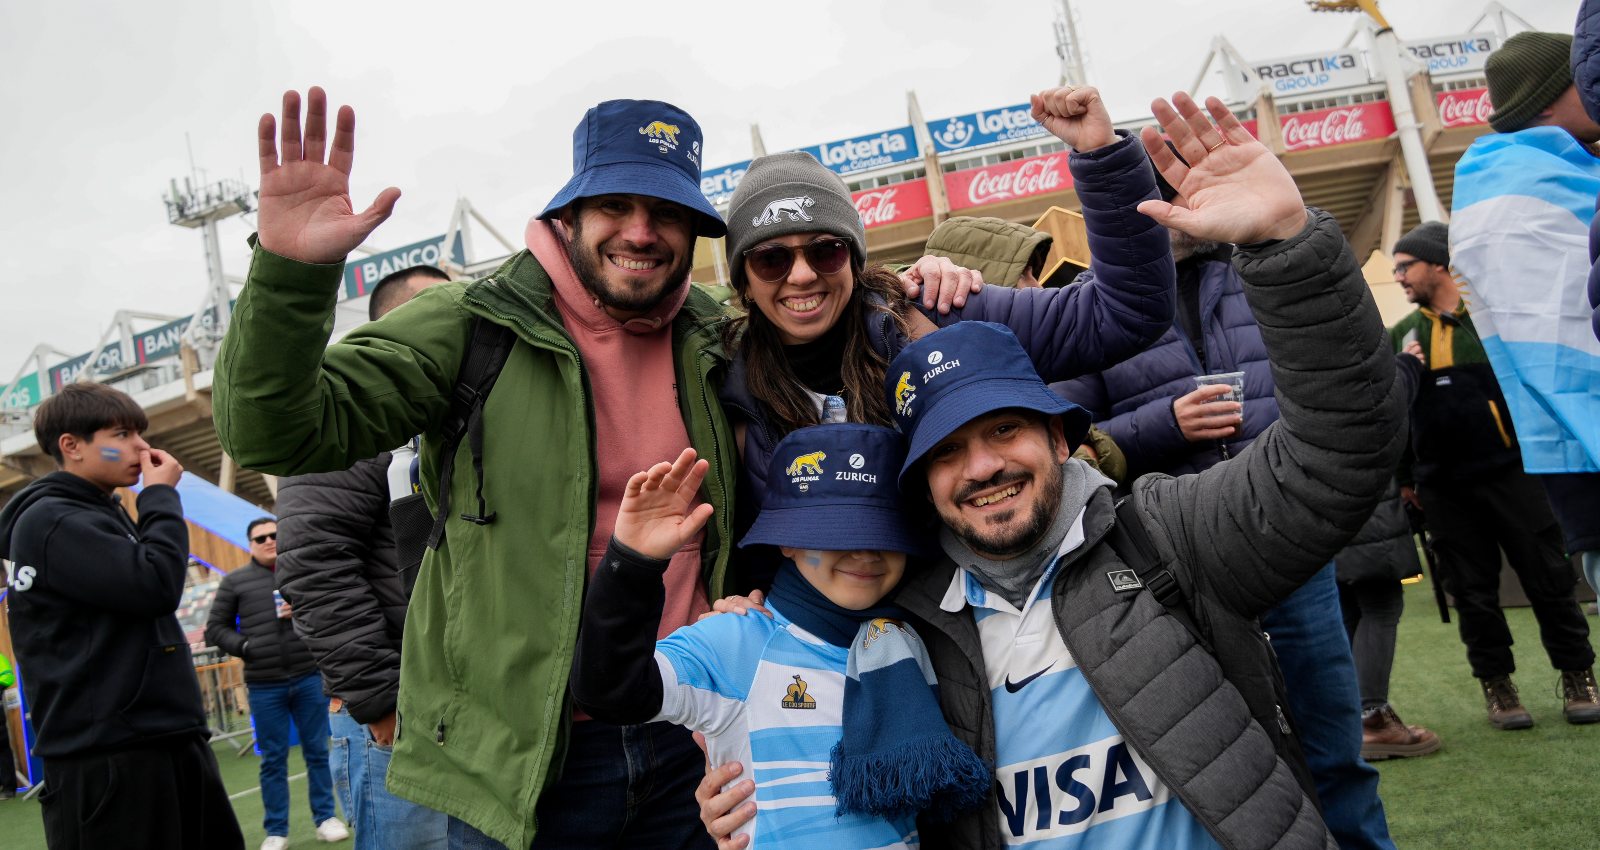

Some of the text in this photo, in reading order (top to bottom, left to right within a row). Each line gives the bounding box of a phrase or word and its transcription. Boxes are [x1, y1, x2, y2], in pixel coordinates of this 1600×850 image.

[1429, 56, 1469, 70] ROUP
[1275, 74, 1329, 92] GROUP
[1282, 108, 1366, 150] Coca-Cola
[968, 157, 1064, 204] Coca-Cola
[922, 359, 961, 385] ZURICH
[835, 471, 877, 483] ZURICH
[995, 741, 1153, 837] VISA
